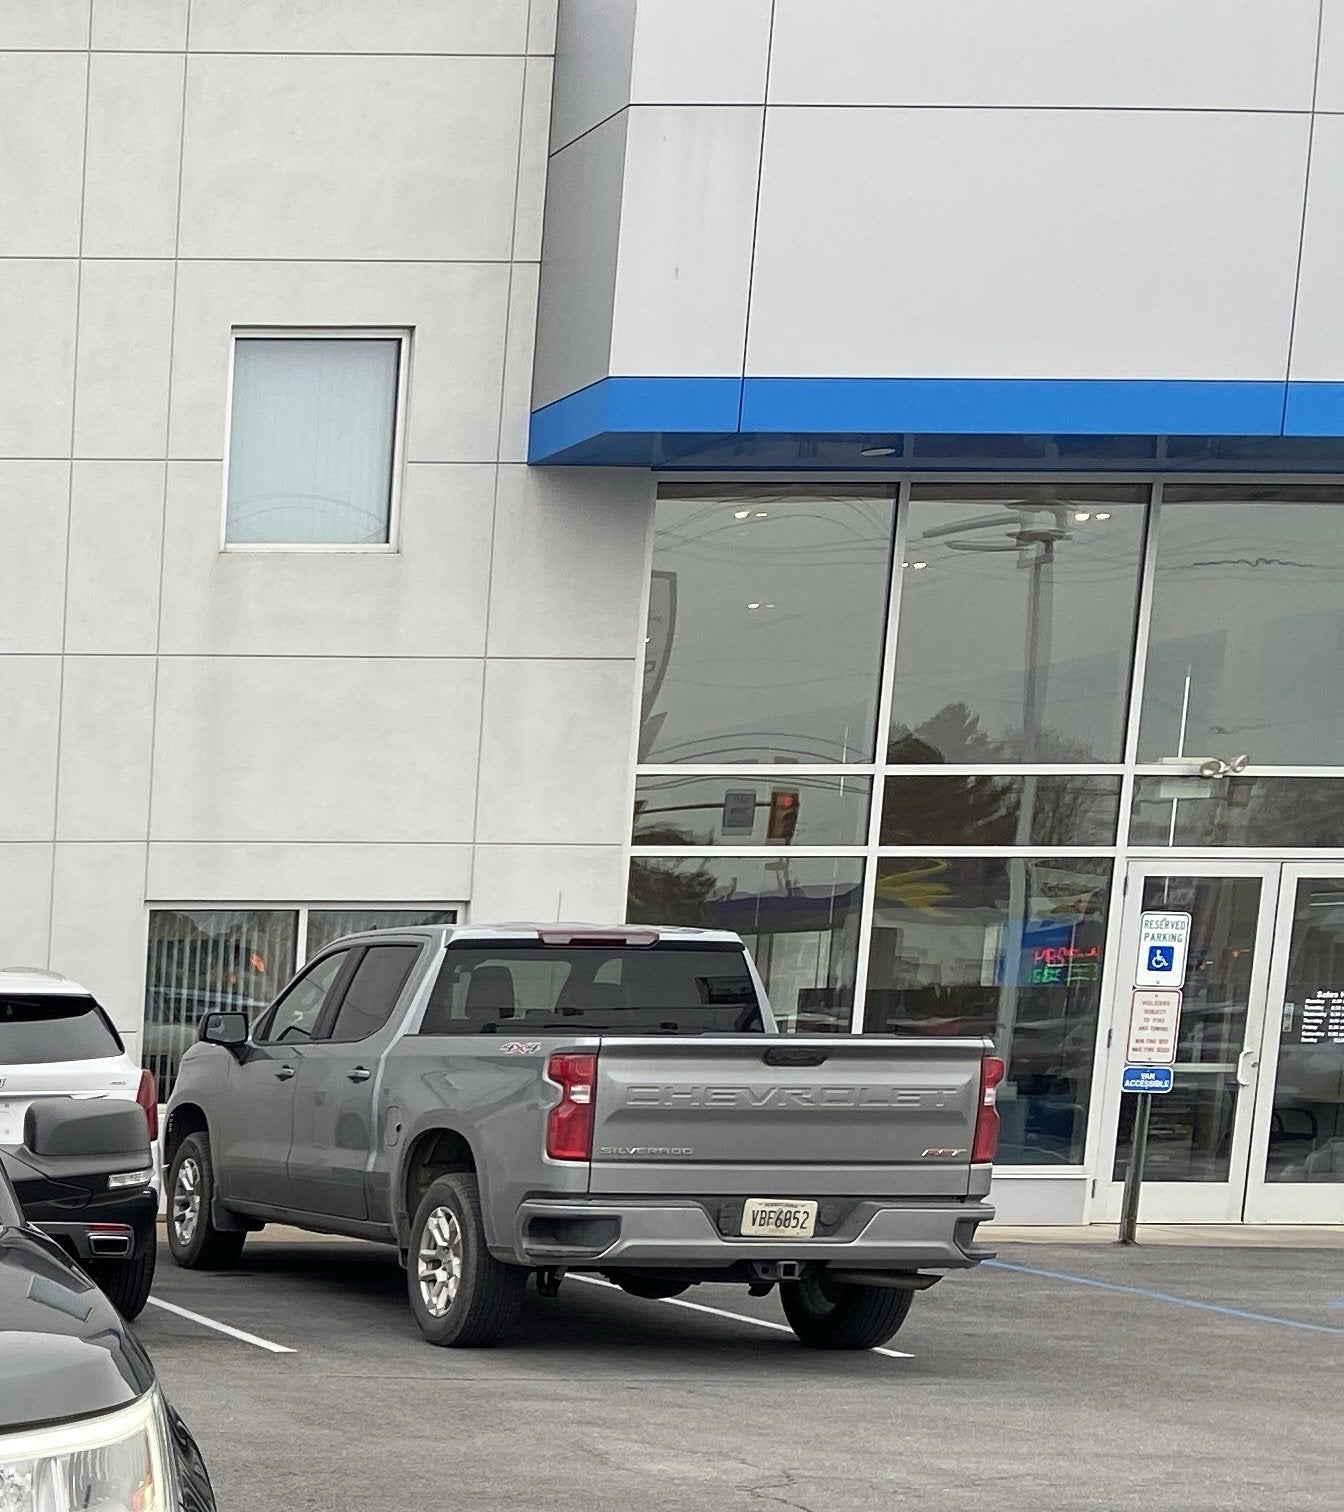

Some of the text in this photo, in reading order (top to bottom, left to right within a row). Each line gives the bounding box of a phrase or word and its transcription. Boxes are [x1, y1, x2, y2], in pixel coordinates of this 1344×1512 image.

[1143, 919, 1187, 931] RESERVED
[1143, 932, 1184, 943] PARKING
[1140, 1072, 1156, 1080] VAN
[1124, 1080, 1170, 1088] ACCESSIBLE
[626, 1086, 957, 1107] CHEVROLET
[599, 1146, 694, 1155] SILVERADO
[751, 1209, 810, 1230] VBF6852
